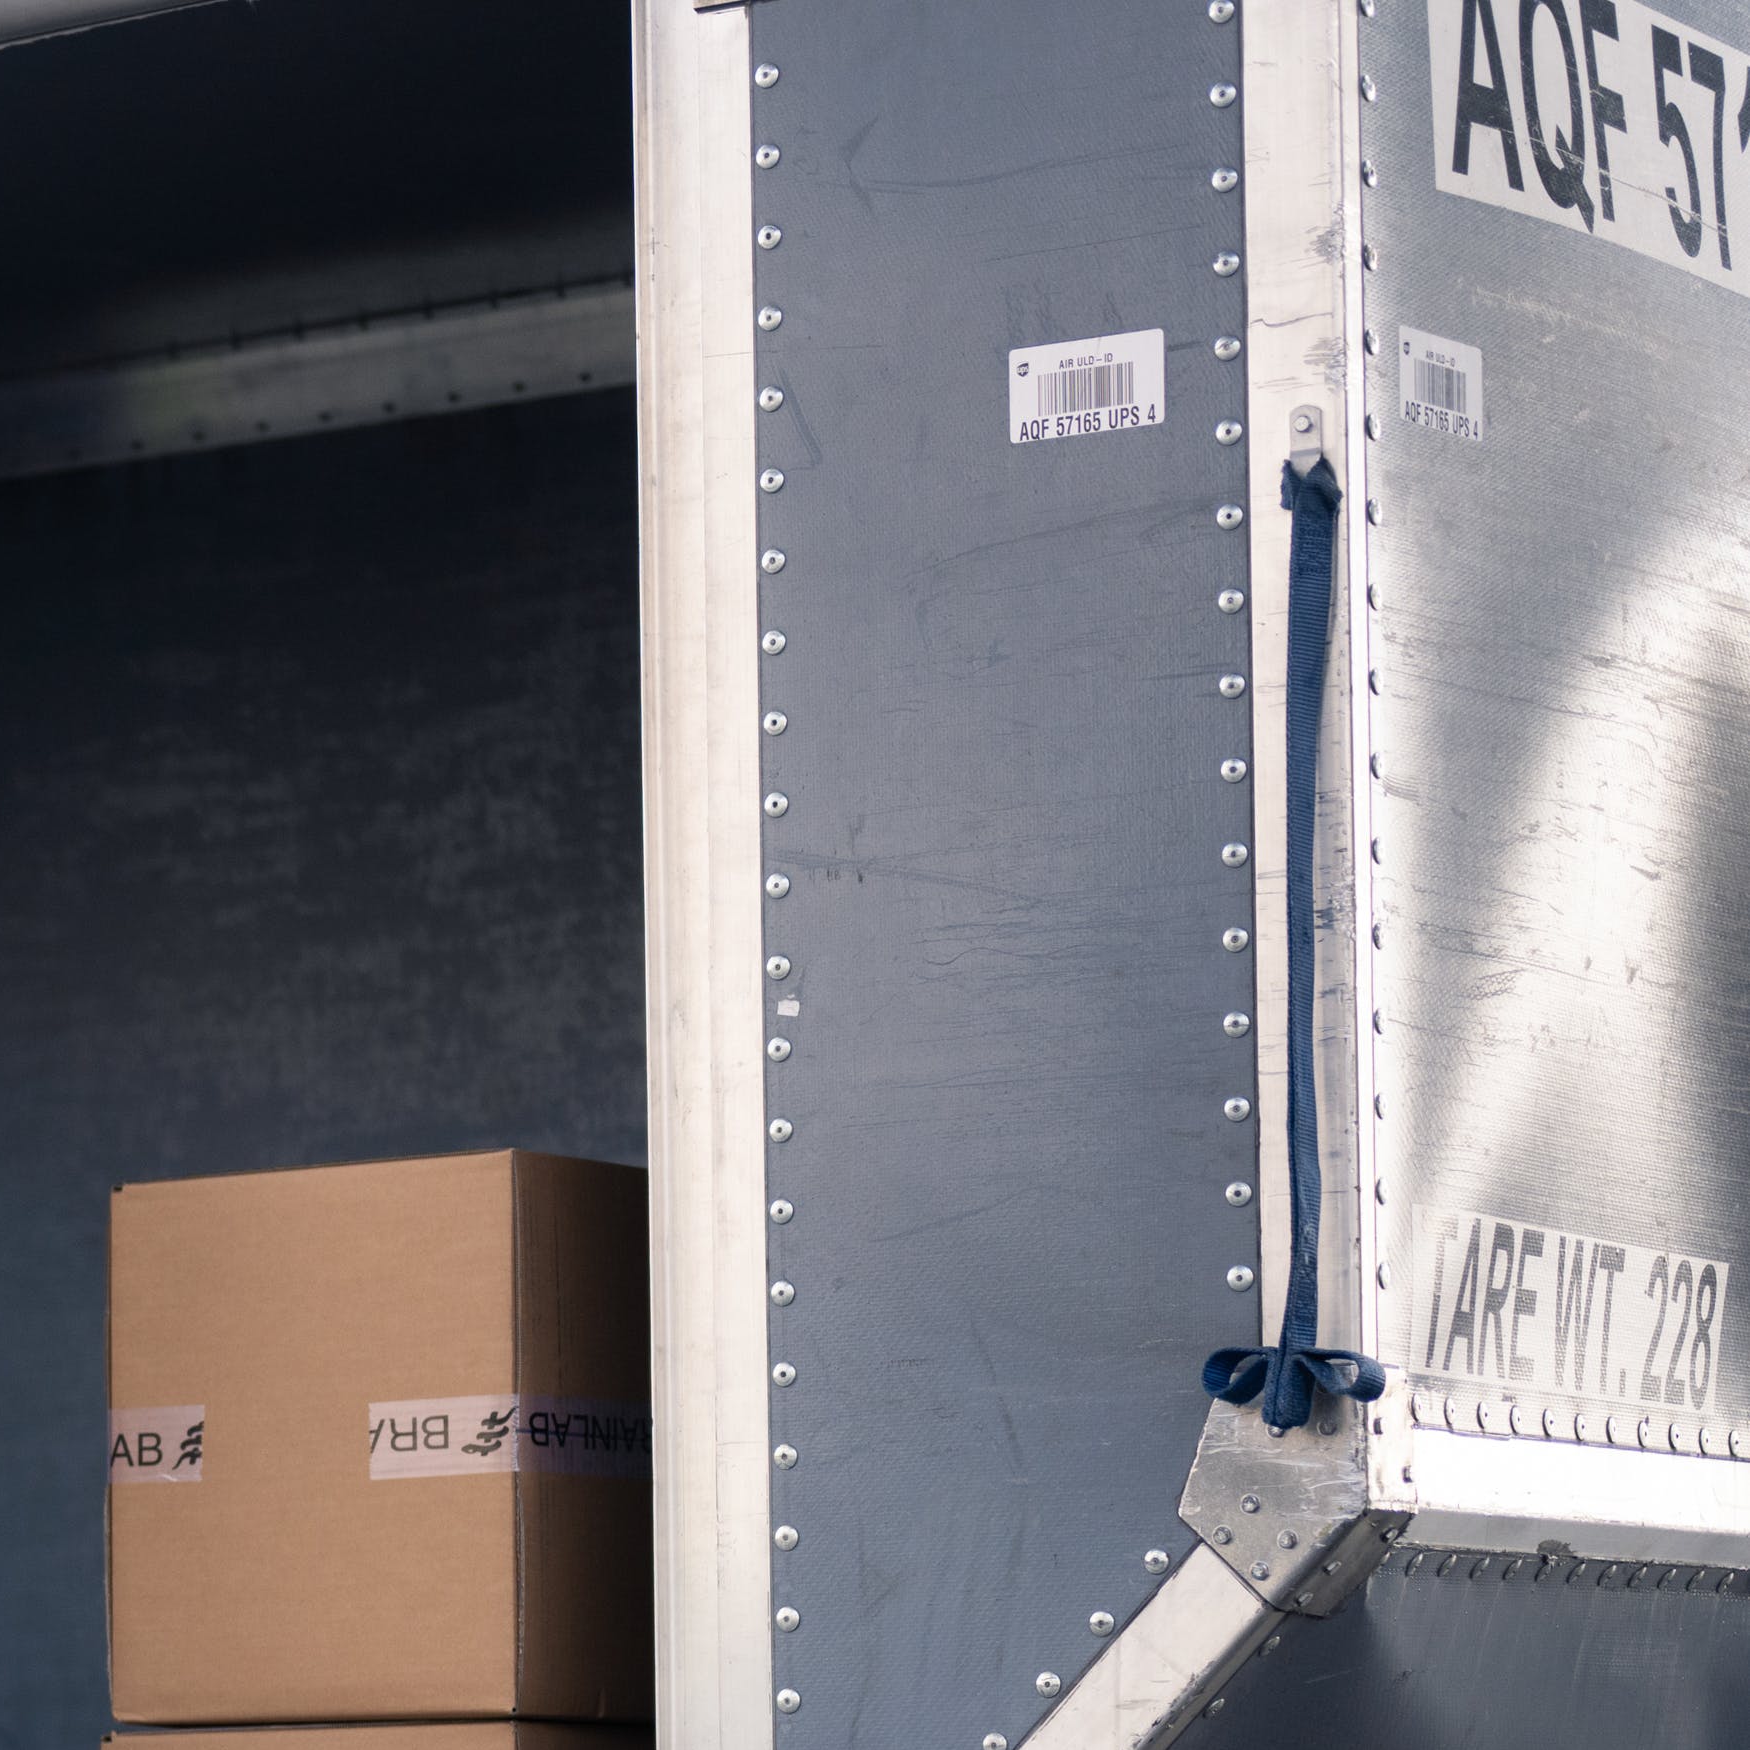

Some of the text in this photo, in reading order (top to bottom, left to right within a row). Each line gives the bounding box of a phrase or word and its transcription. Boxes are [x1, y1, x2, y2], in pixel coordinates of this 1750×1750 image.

[1452, 0, 1750, 272] AQF 57
[1059, 358, 1074, 370] AIR
[1020, 404, 1156, 442] AQF 57165 UPS 4
[1405, 400, 1478, 440] AQF 57165 UPS 4
[1424, 1211, 1545, 1381] TARE
[1641, 1256, 1718, 1409] 228
[110, 1432, 163, 1468] AB
